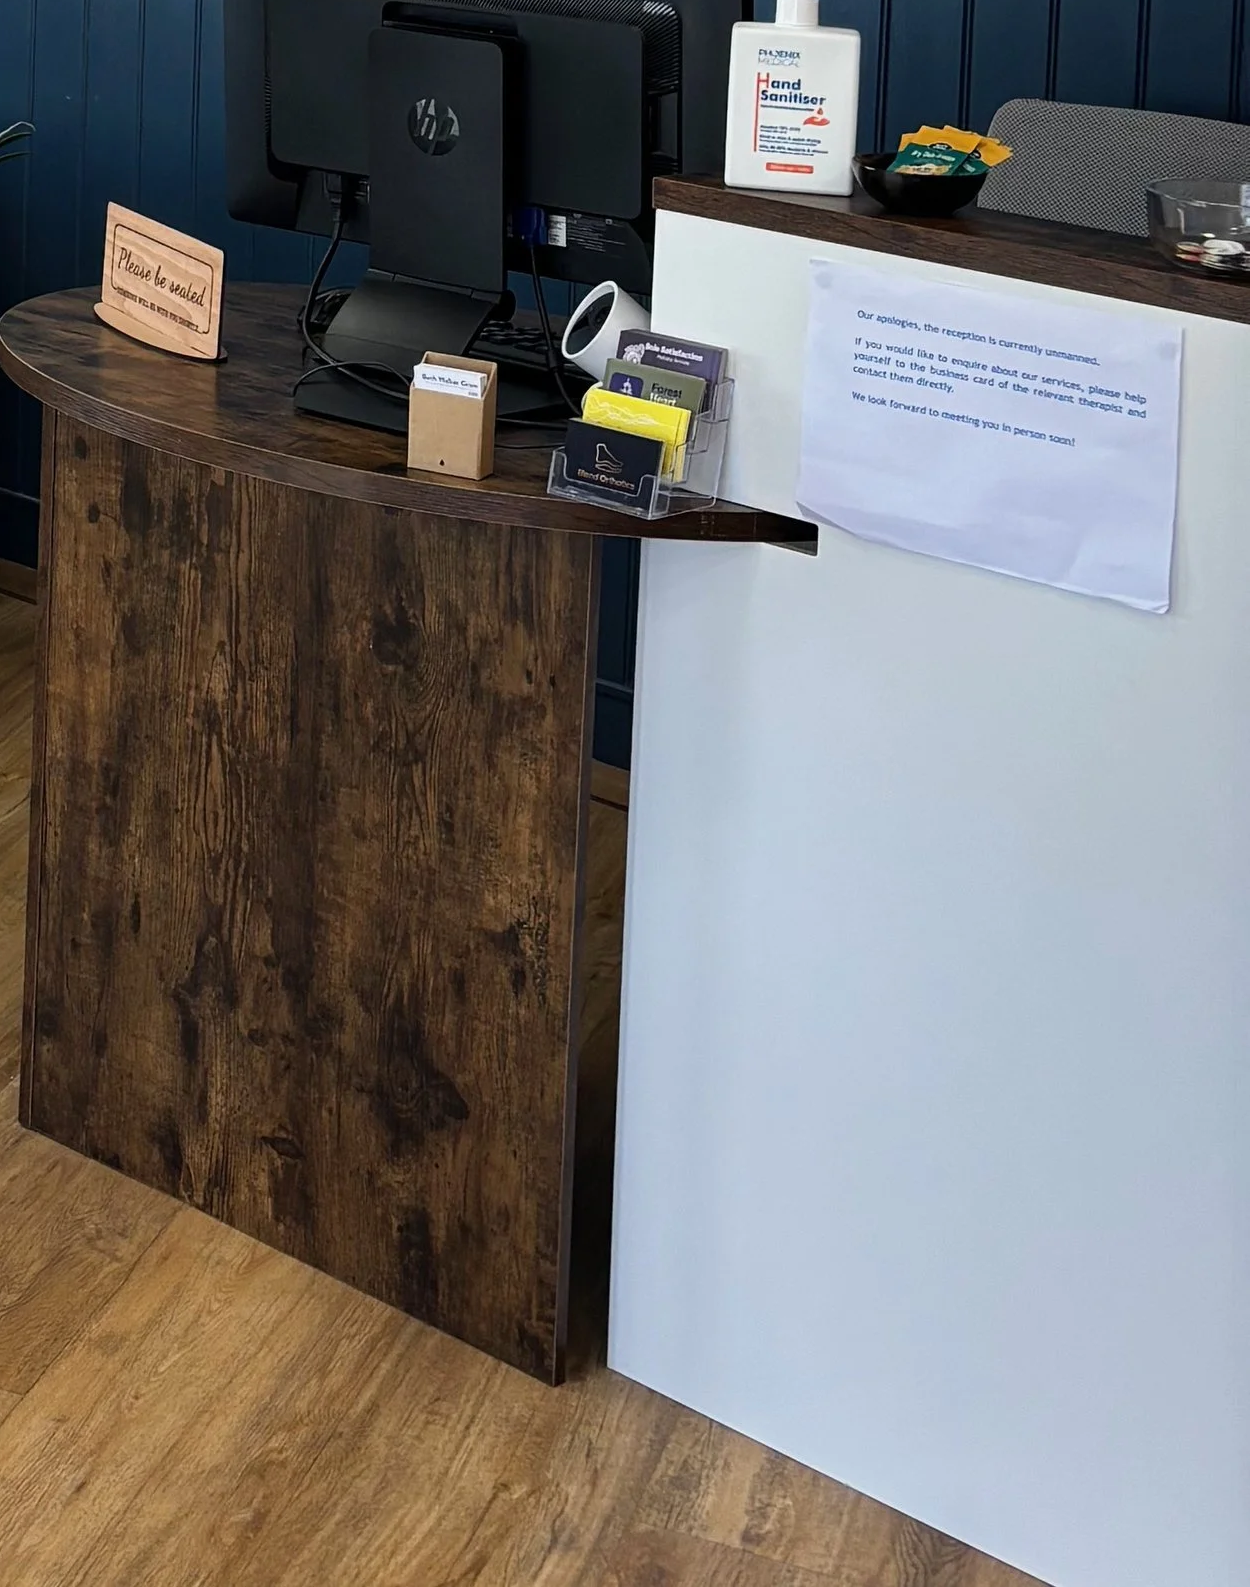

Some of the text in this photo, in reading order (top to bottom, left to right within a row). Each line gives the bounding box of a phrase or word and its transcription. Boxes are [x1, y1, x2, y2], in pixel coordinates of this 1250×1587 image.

[757, 72, 802, 91] Hand
[760, 89, 827, 106] Sanitiser
[118, 247, 207, 307] Please be seated
[857, 309, 1100, 366] Our apologies, the reception is currently unmanned.
[651, 382, 682, 399] Forest
[852, 365, 887, 379] contact
[890, 371, 914, 384] them
[854, 337, 1147, 405] If you would like to enquire about our services, please help
[854, 352, 1147, 419] yourself to the business card of the relevant therapist and
[852, 391, 1076, 447] We look forward to meeting you in person soon!
